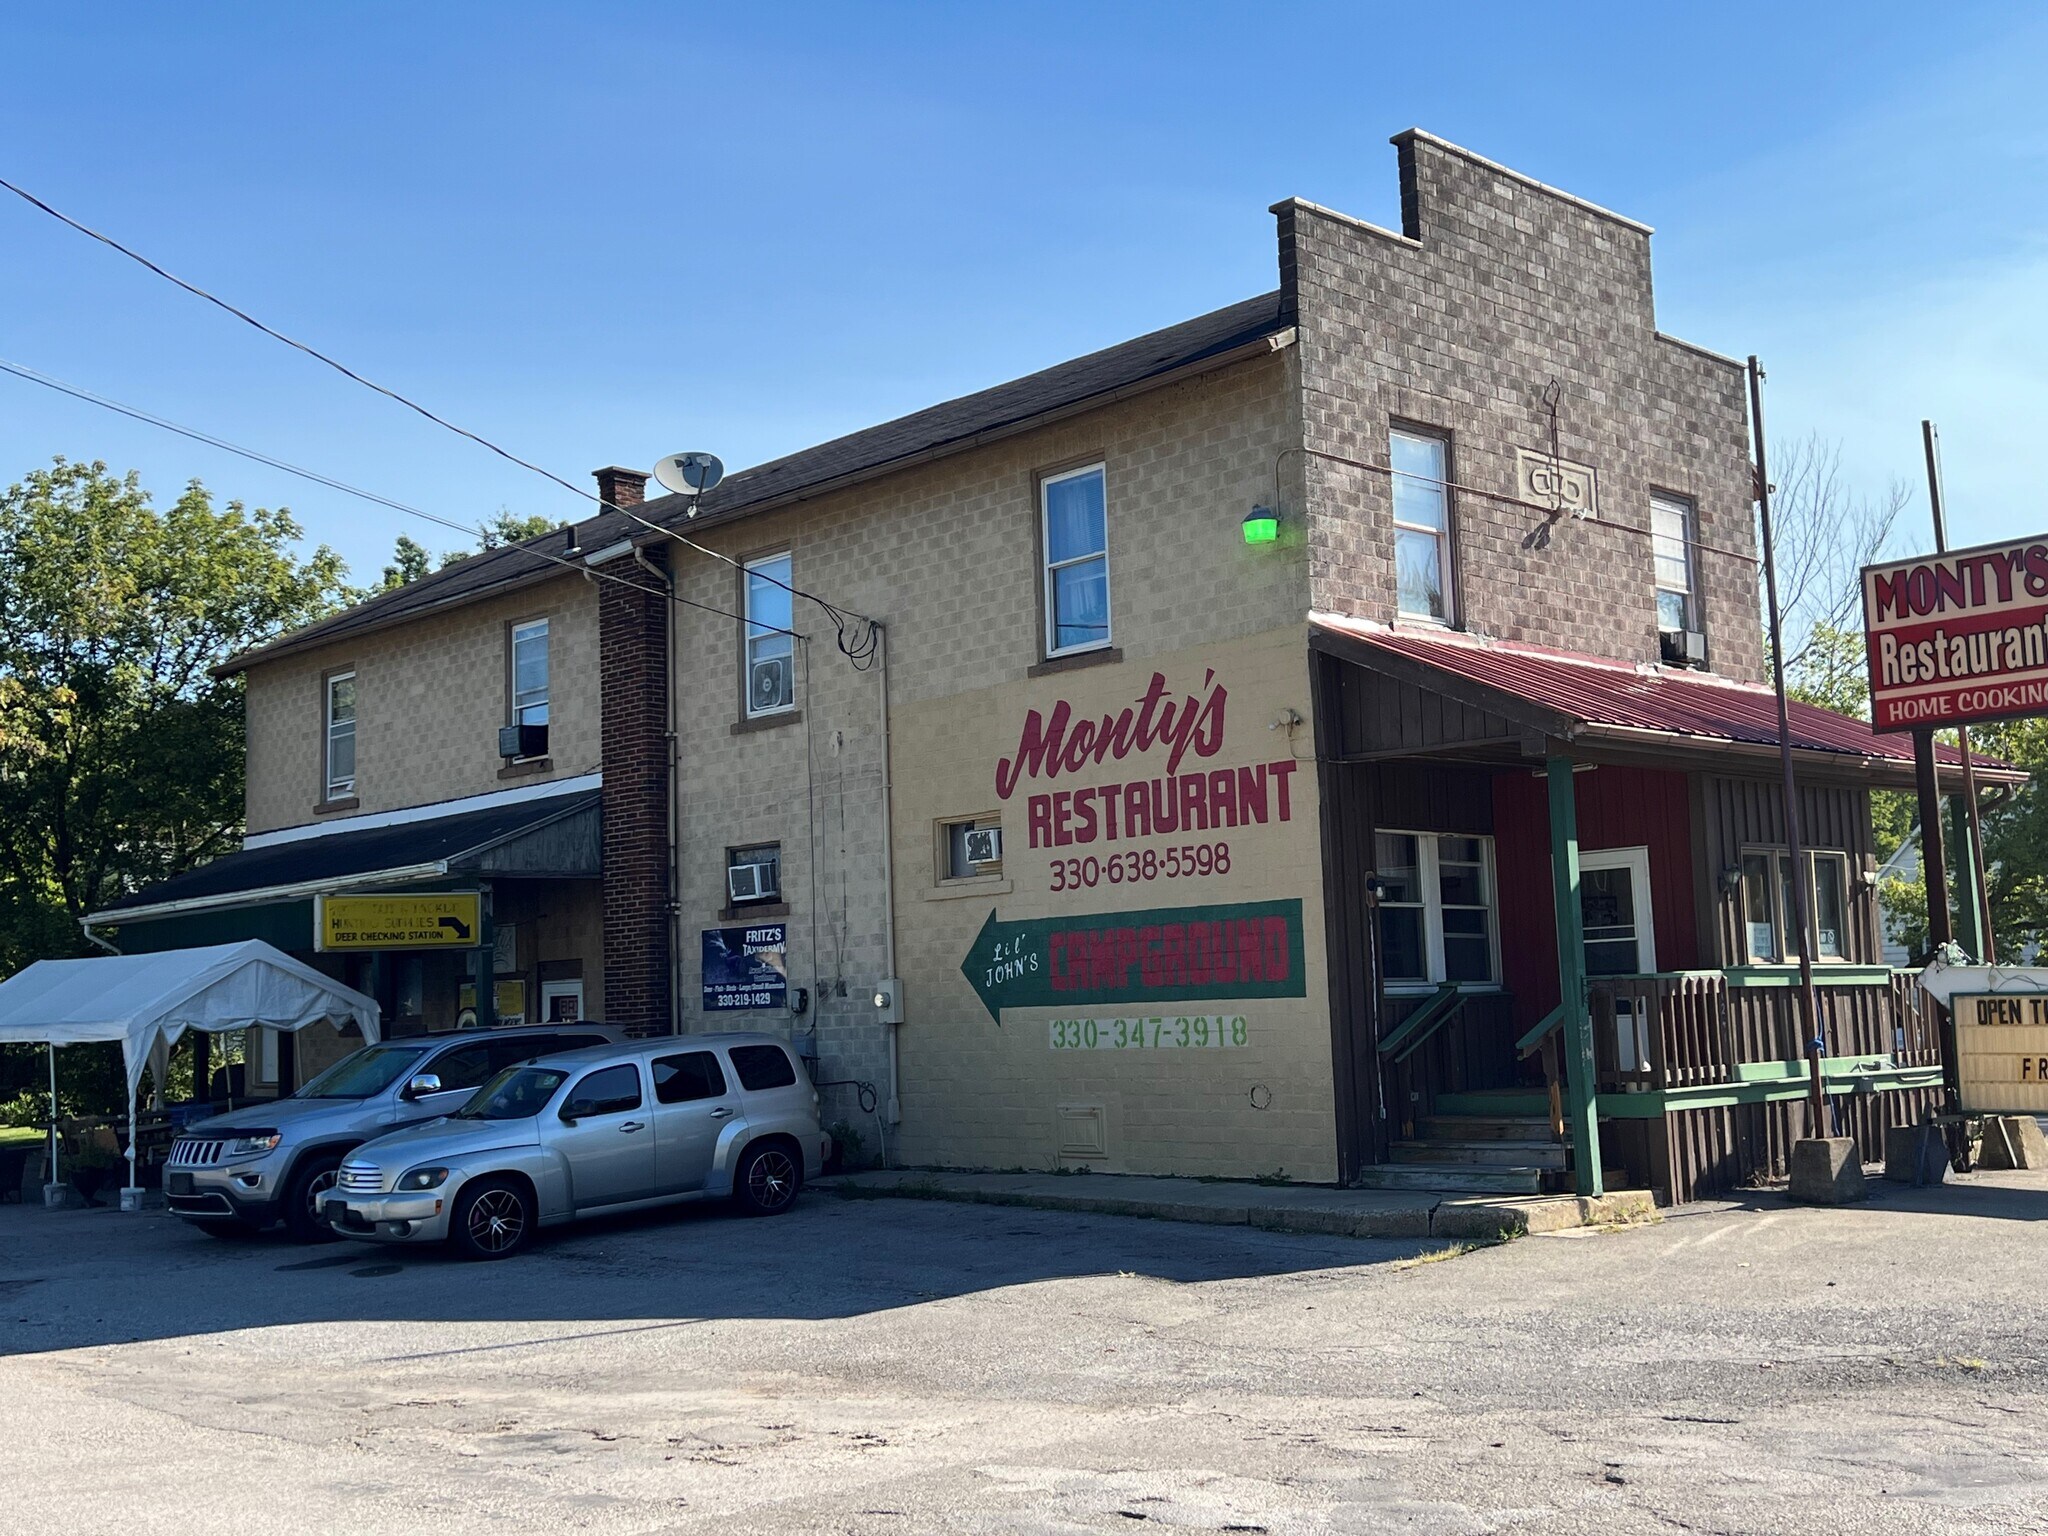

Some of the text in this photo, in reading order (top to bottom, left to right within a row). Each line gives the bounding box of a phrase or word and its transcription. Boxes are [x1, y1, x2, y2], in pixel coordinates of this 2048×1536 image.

[1874, 545, 2048, 622] MONTY'S
[1888, 695, 1953, 722] HOME
[996, 667, 1228, 799] Monty's
[1027, 760, 1298, 850] RESTAURANT
[335, 930, 444, 942] DEER CHECKING STATION
[742, 941, 786, 957] TAXIDERMY
[745, 928, 782, 943] FRITZ'S
[985, 951, 1039, 988] JOHN'S
[1049, 916, 1290, 992] CAMPGROUND
[717, 992, 771, 1007] 330-219-1429
[1977, 999, 2022, 1025] OPEN
[1051, 1015, 1247, 1050] 330-347-3918
